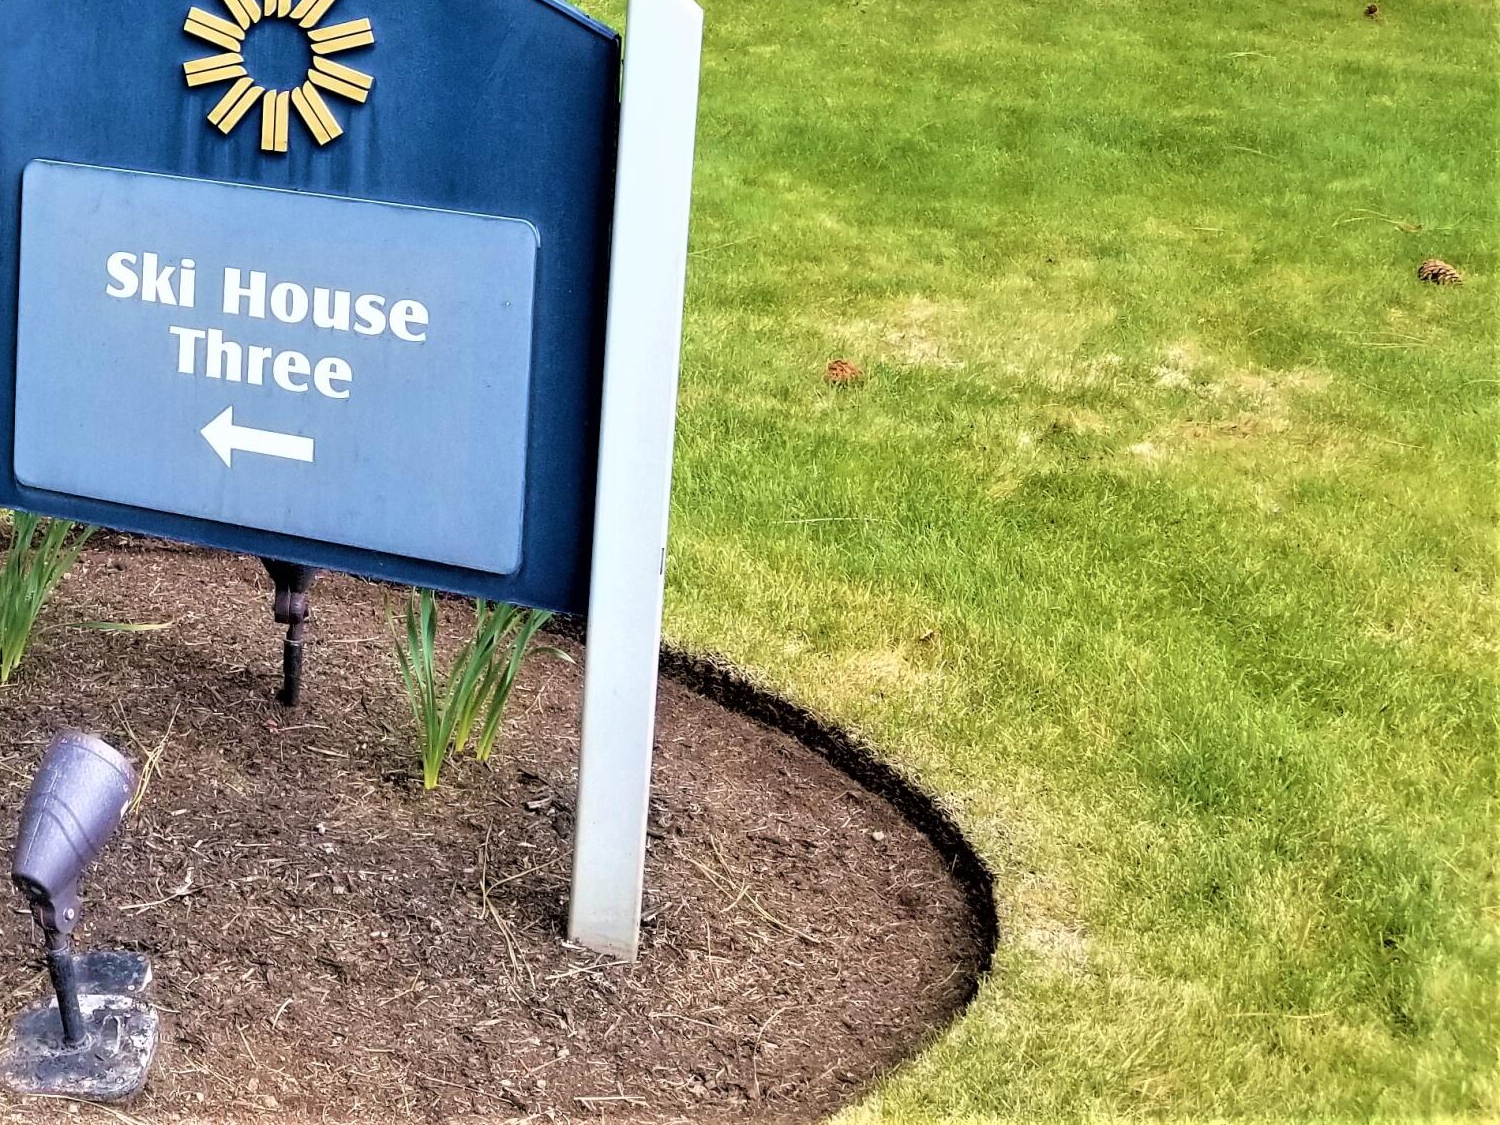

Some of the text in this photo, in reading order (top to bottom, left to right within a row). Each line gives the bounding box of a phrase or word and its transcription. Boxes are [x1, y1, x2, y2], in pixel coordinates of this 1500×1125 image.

[105, 251, 429, 342] Ski House
[168, 325, 353, 399] Three
